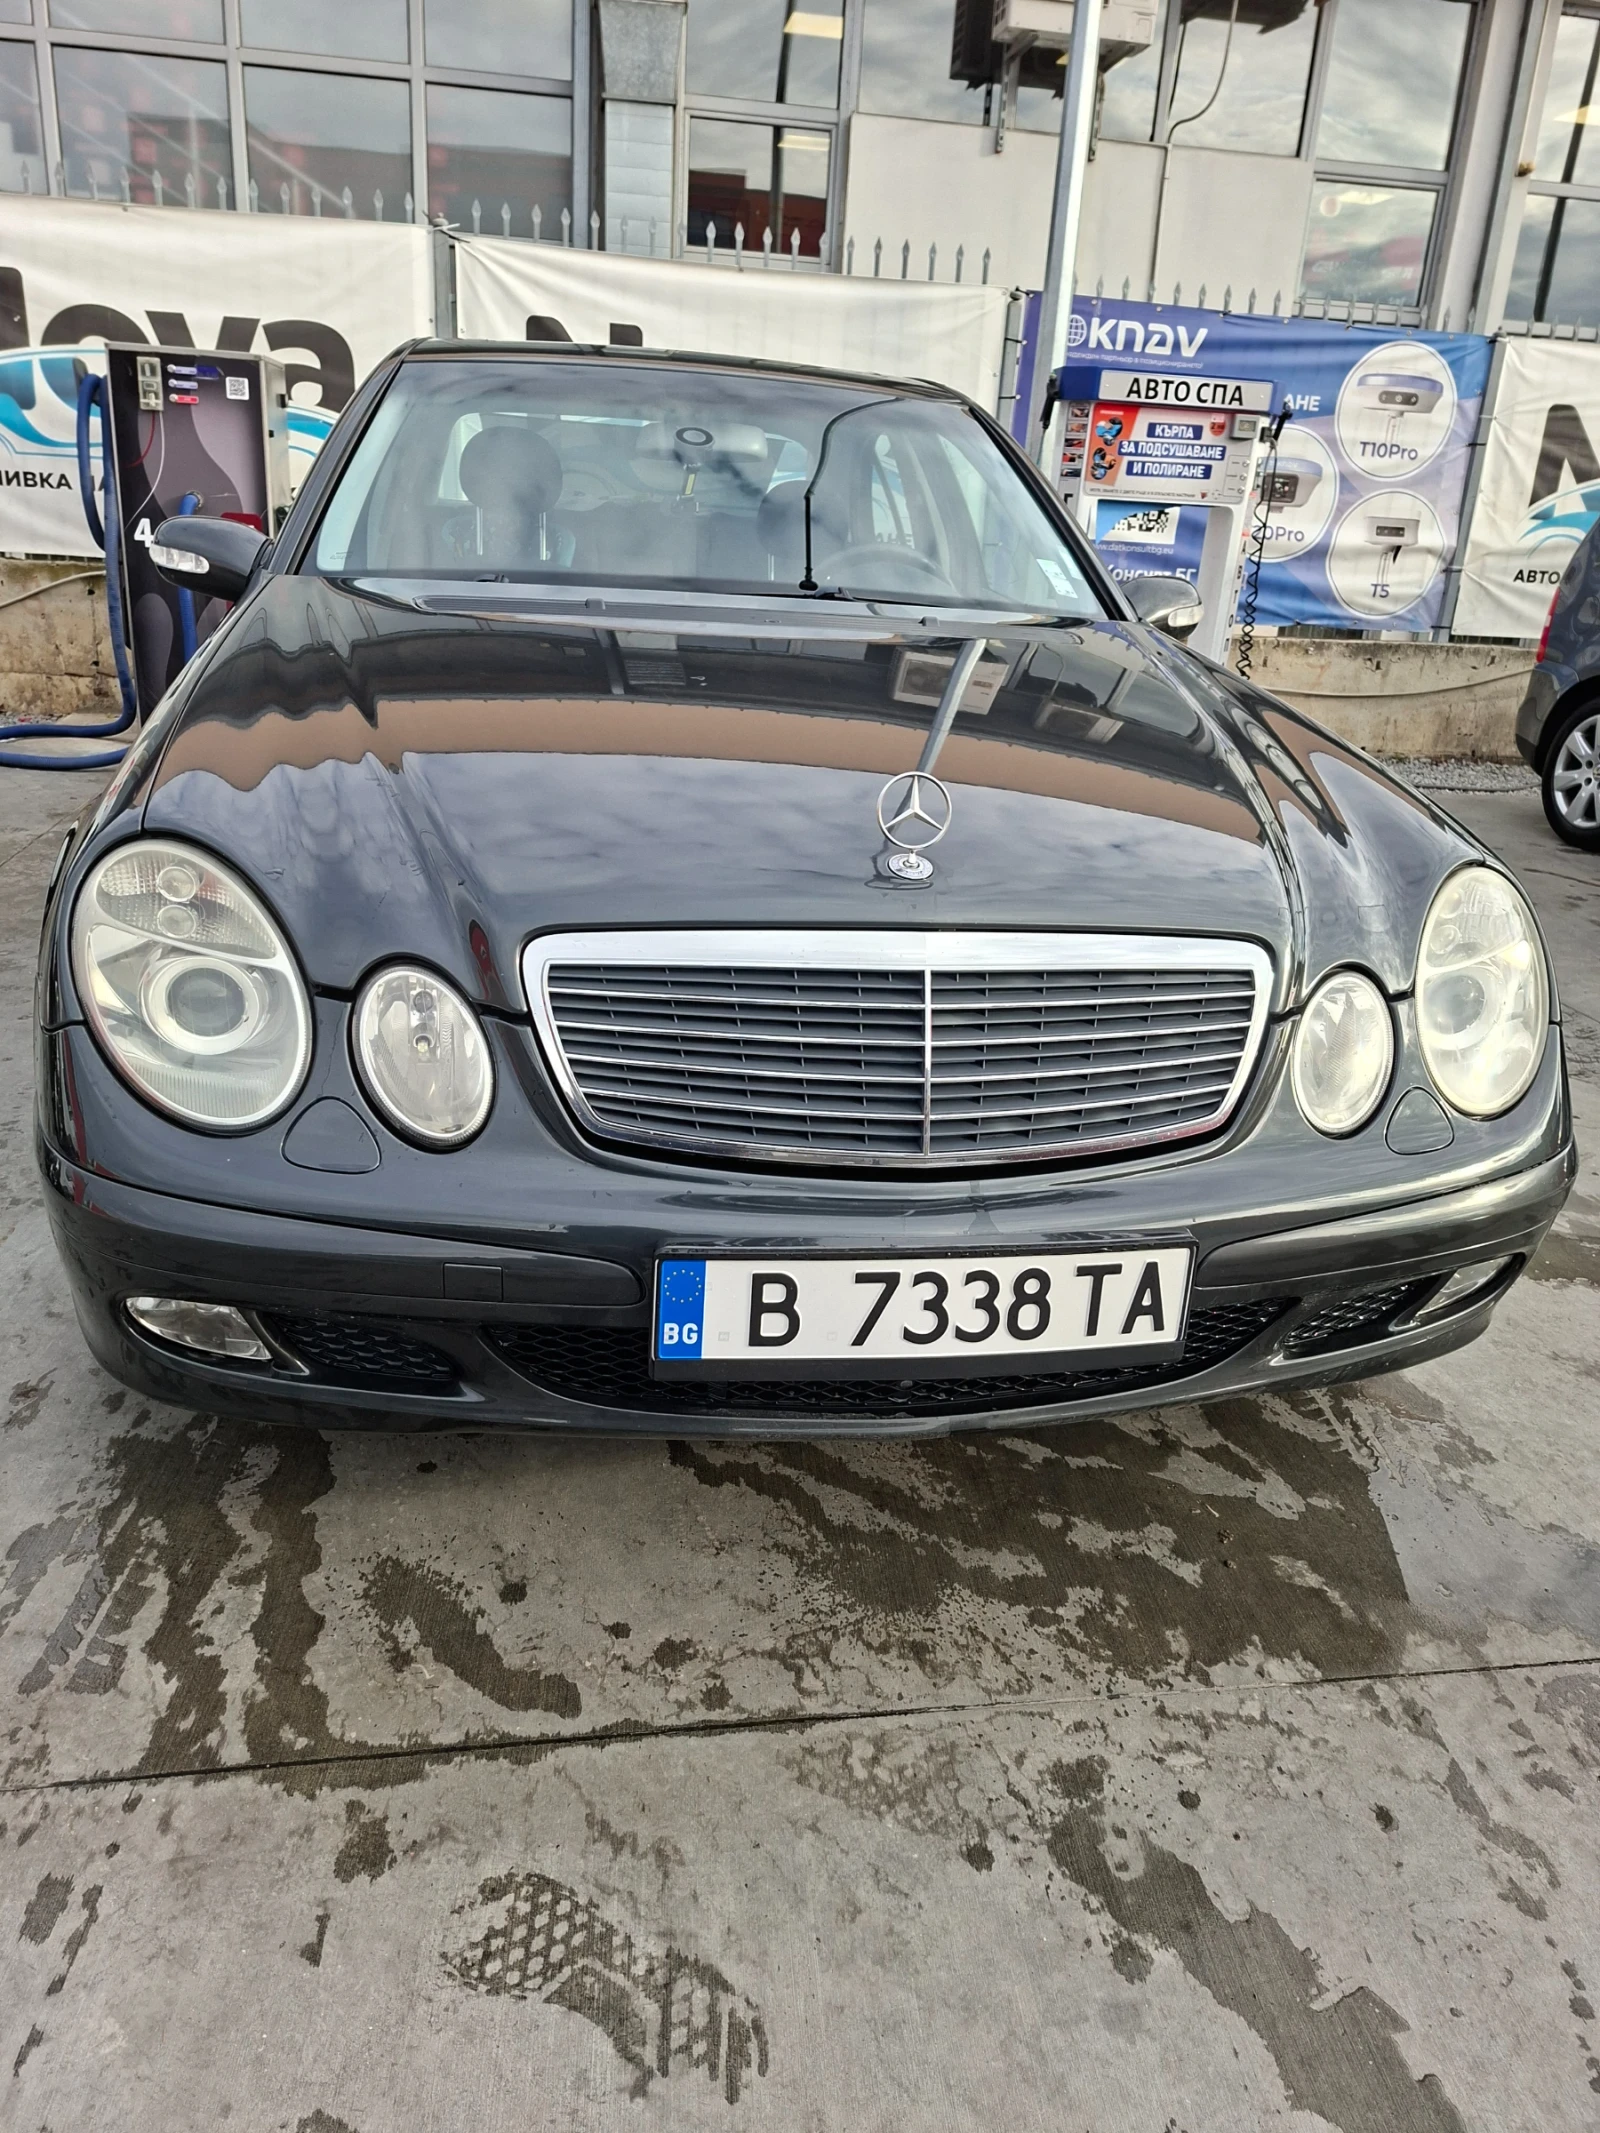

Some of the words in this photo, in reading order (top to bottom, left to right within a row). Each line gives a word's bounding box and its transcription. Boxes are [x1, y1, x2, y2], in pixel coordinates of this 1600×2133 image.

[1126, 377, 1191, 402] АВТО
[1196, 382, 1244, 406] СПА
[1155, 424, 1195, 439] КЪРПА
[1120, 441, 1137, 454] ЗА
[1138, 443, 1223, 459] ПОДСУШАВАНЕ
[1359, 441, 1418, 461] T10Pro
[0, 469, 73, 490] ИВКА
[1132, 463, 1144, 475] И
[1145, 463, 1206, 478] ПОЛИРАНЕ
[133, 517, 154, 548] 4
[1370, 583, 1390, 599] T5
[748, 1271, 801, 1348] B
[849, 1267, 1052, 1347] 7338
[1076, 1261, 1166, 1338] TA
[663, 1322, 698, 1345] BG
